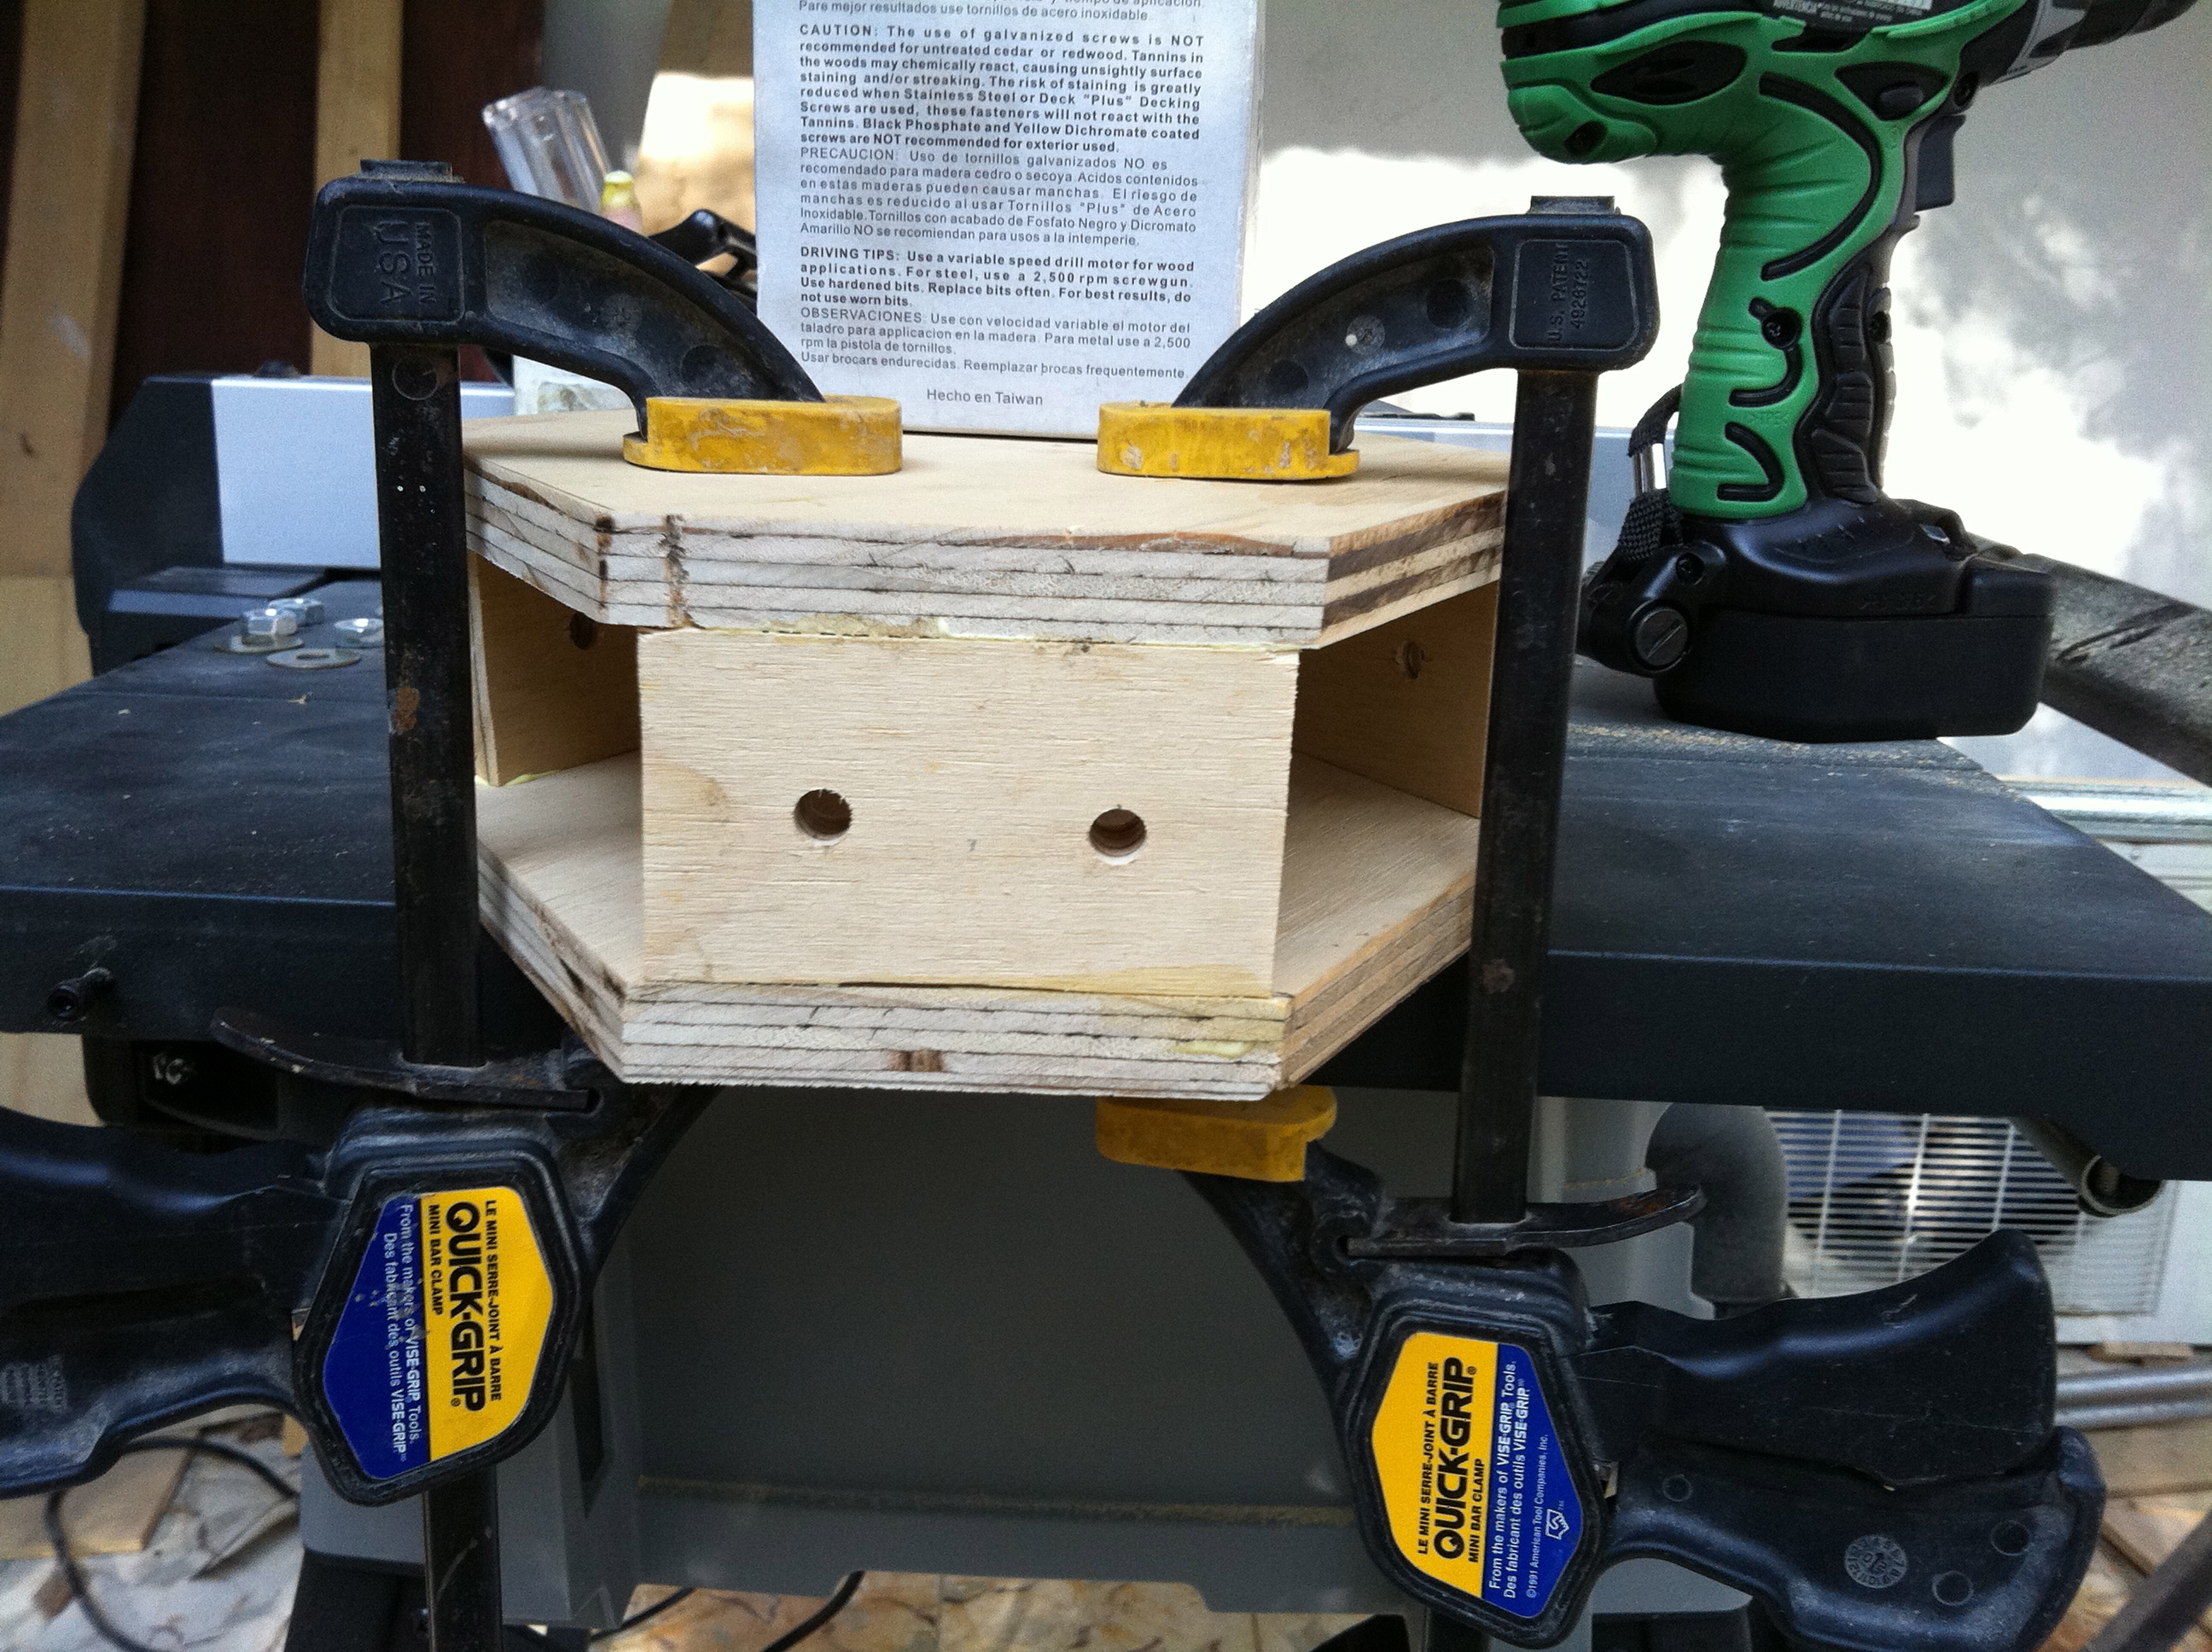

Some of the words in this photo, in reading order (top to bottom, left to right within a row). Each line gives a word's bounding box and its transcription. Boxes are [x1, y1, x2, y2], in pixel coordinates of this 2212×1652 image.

[888, 26, 915, 38] The
[924, 30, 951, 38] use
[960, 29, 975, 39] of
[984, 30, 1074, 42] galvanized
[1083, 35, 1139, 44] screws
[1149, 35, 1161, 45] is
[1171, 36, 1204, 46] NOT
[800, 42, 896, 53] recommended
[900, 43, 919, 53] for
[923, 44, 990, 55] untreated
[994, 46, 1033, 56] cedar
[1041, 49, 1055, 58] or
[1131, 50, 1186, 62] Tannins
[1191, 52, 1203, 63] in
[800, 56, 822, 67] the
[824, 57, 867, 68] woods
[871, 60, 898, 72] may
[902, 59, 976, 73] chemically
[1023, 63, 1077, 76] causing
[1081, 65, 1146, 79] unsightly
[1150, 67, 1202, 78] surface
[800, 72, 856, 85] staining
[864, 73, 909, 84] and/or
[989, 77, 1015, 87] The
[1020, 78, 1045, 88] risk
[1051, 79, 1064, 89] of
[1068, 79, 1126, 93] staining
[1134, 81, 1146, 91] is
[1150, 84, 1201, 96] greatly
[800, 87, 858, 98] reduced
[862, 89, 899, 99] when
[904, 90, 973, 102] Stainless
[978, 91, 1016, 102] Steel
[1020, 95, 1035, 103] or
[1039, 93, 1075, 104] Deck
[1139, 96, 1200, 111] Decking
[800, 102, 850, 113] Screws
[854, 105, 876, 113] are
[927, 105, 966, 116] these
[970, 106, 1039, 119] fasteners
[1045, 108, 1069, 119] will
[1074, 111, 1097, 120] not
[1101, 113, 1138, 122] react
[1143, 113, 1173, 123] with
[1177, 114, 1199, 125] the
[864, 118, 901, 129] Black
[905, 119, 981, 132] Phosphate
[985, 122, 1010, 132] and
[1015, 122, 1061, 134] Yellow
[1065, 125, 1147, 137] Dichromate
[1151, 129, 1200, 139] coated
[800, 134, 846, 143] screws
[849, 136, 870, 144] are
[874, 134, 901, 145] NOT
[905, 137, 1000, 148] recommended
[1004, 137, 1022, 148] for
[1027, 139, 1079, 150] exterior
[416, 222, 435, 276] MADE
[800, 246, 859, 259] DRIVING
[907, 251, 933, 262] Use
[948, 253, 1004, 265] variable
[1009, 256, 1051, 268] speed
[1055, 257, 1083, 268] drill
[1087, 259, 1129, 270] motor
[1133, 259, 1152, 270] for
[1157, 260, 1194, 270] wood
[374, 220, 412, 304] USA
[906, 266, 931, 276] For
[935, 268, 979, 281] steel,
[984, 271, 1010, 280] use
[1018, 272, 1025, 281] a
[1033, 270, 1074, 283] 2,500
[1080, 275, 1108, 286] rpm
[419, 285, 436, 303] IN
[800, 277, 824, 288] Use
[829, 278, 891, 290] hardened
[928, 282, 982, 295] Replace
[987, 285, 1011, 296] bits
[1059, 287, 1081, 298] For
[1086, 288, 1115, 299] best
[1118, 290, 1170, 303] results,
[1174, 291, 1191, 302] do
[800, 293, 821, 302] not
[824, 294, 847, 303] use
[850, 296, 881, 305] worn
[927, 389, 970, 401] Hecho
[975, 394, 991, 403] en
[995, 393, 1043, 404] Taiwan
[428, 1204, 440, 1234] MINI
[485, 1200, 497, 1216] LE
[399, 1204, 414, 1239] From
[384, 1233, 398, 1258] Des
[486, 1220, 498, 1251] MINI
[401, 1242, 415, 1264] the
[429, 1239, 441, 1265] BAR
[430, 1269, 444, 1316] CLAMP
[486, 1254, 501, 1341] SERRE-JOINT
[388, 1351, 402, 1387] outils
[490, 1358, 503, 1402] BARRE
[1426, 1362, 1439, 1405] BARRE
[1420, 1422, 1435, 1504] SERRE-JOINT
[1512, 1454, 1526, 1489] outils
[1472, 1458, 1485, 1503] CLAMP
[1496, 1469, 1509, 1483] of
[1493, 1486, 1507, 1532] makers
[1509, 1492, 1522, 1515] des
[1532, 1506, 1544, 1525] Tool
[1418, 1507, 1430, 1536] MINI
[1470, 1505, 1482, 1532] BAR
[1417, 1539, 1429, 1555] LE
[1468, 1534, 1480, 1563] MINI
[1491, 1535, 1505, 1555] the
[1506, 1517, 1522, 1572] fabricant
[1528, 1526, 1542, 1568] American
[1488, 1558, 1502, 1589] From
[1504, 1575, 1517, 1598] Des
